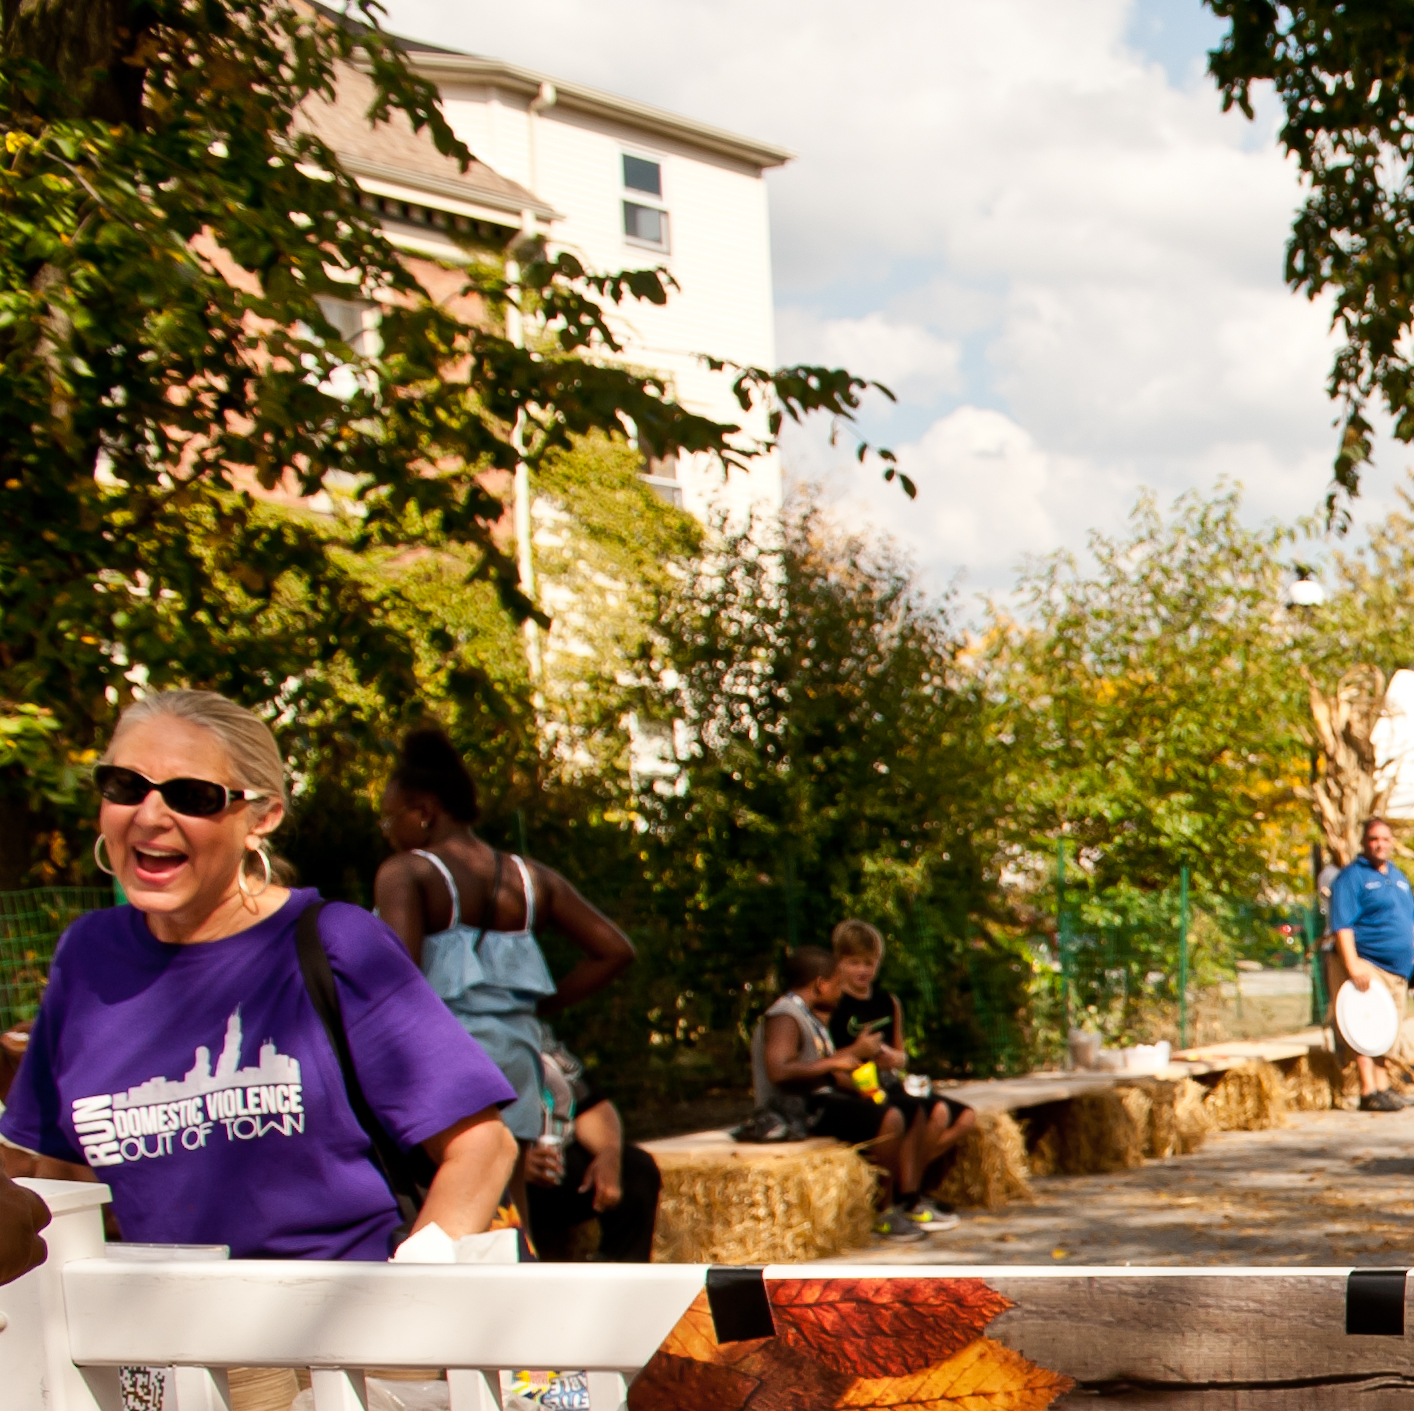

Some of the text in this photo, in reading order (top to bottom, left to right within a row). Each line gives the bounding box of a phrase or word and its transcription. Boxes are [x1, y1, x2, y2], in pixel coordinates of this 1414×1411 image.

[72, 1094, 124, 1167] RUN
[113, 1085, 304, 1139] DOMESTIC VIOLENCE
[120, 1113, 305, 1161] OUT OF TOWN
